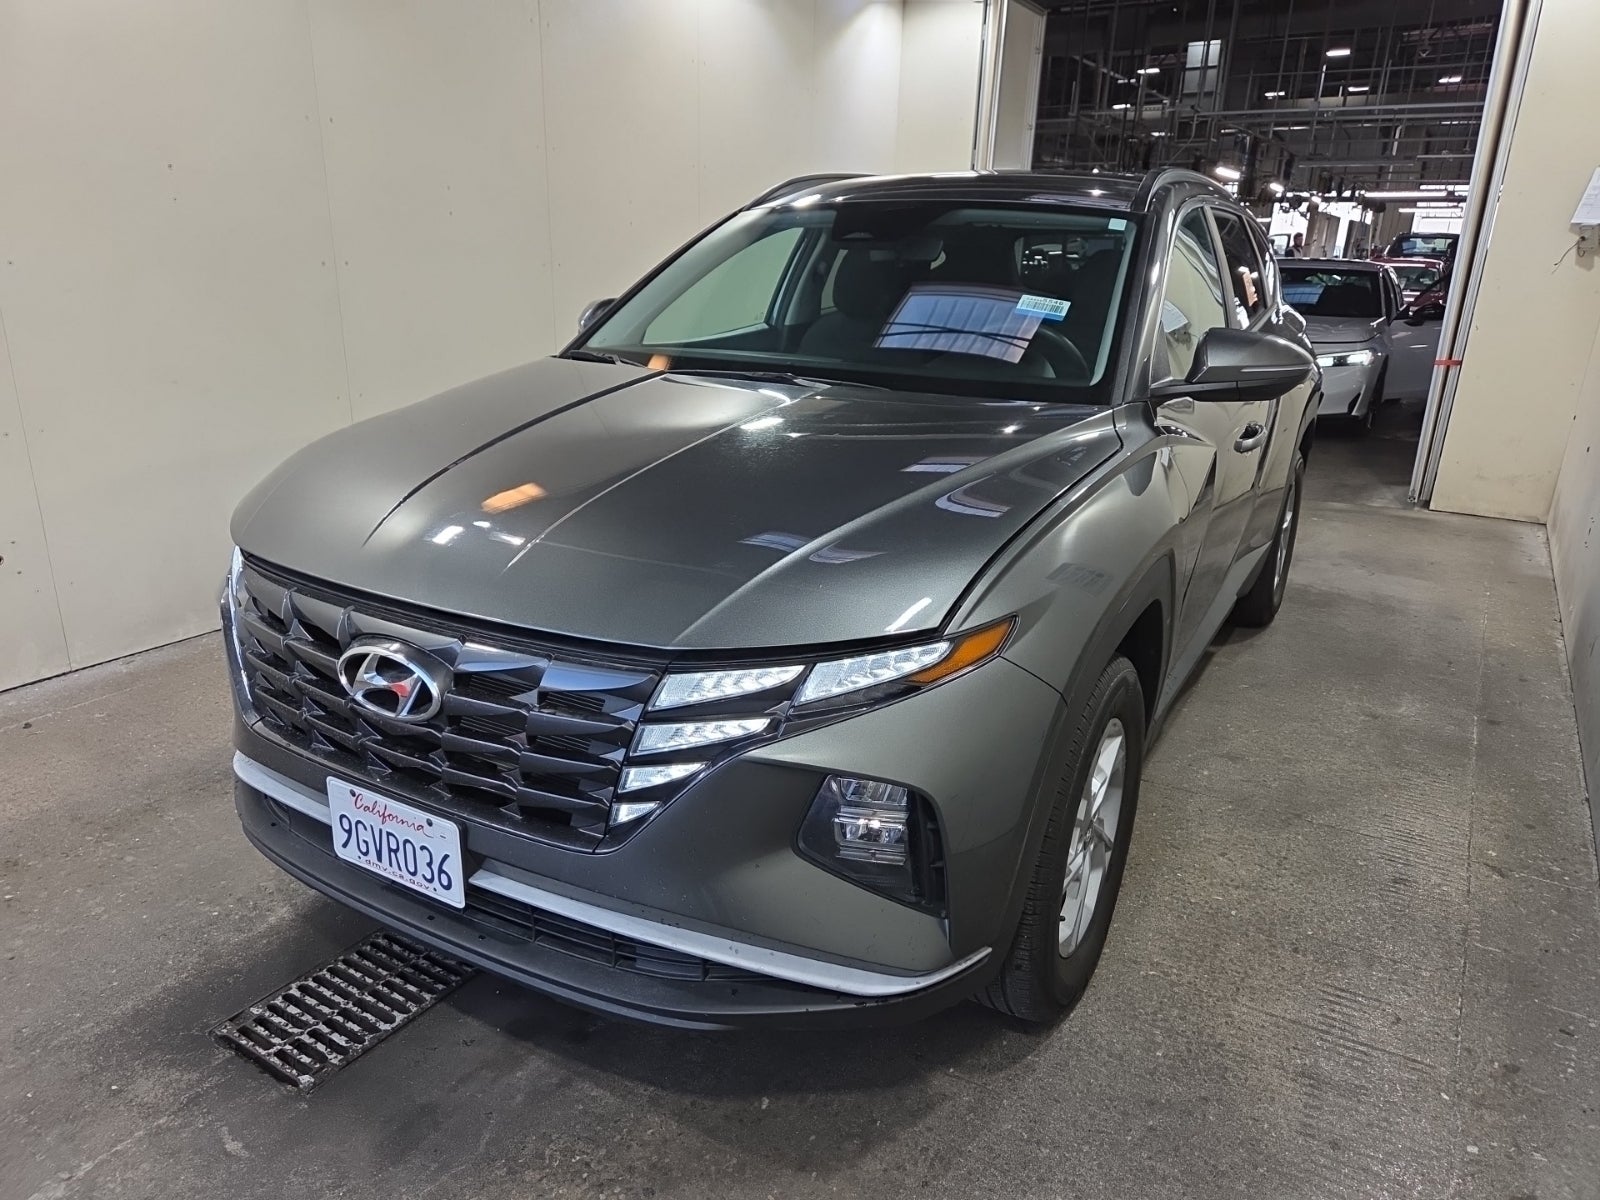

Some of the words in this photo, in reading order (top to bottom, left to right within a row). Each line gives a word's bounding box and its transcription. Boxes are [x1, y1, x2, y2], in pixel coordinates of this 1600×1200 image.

[354, 792, 434, 839] California
[338, 813, 453, 891] 9GVR036
[364, 858, 431, 891] dmv.ca.gov
